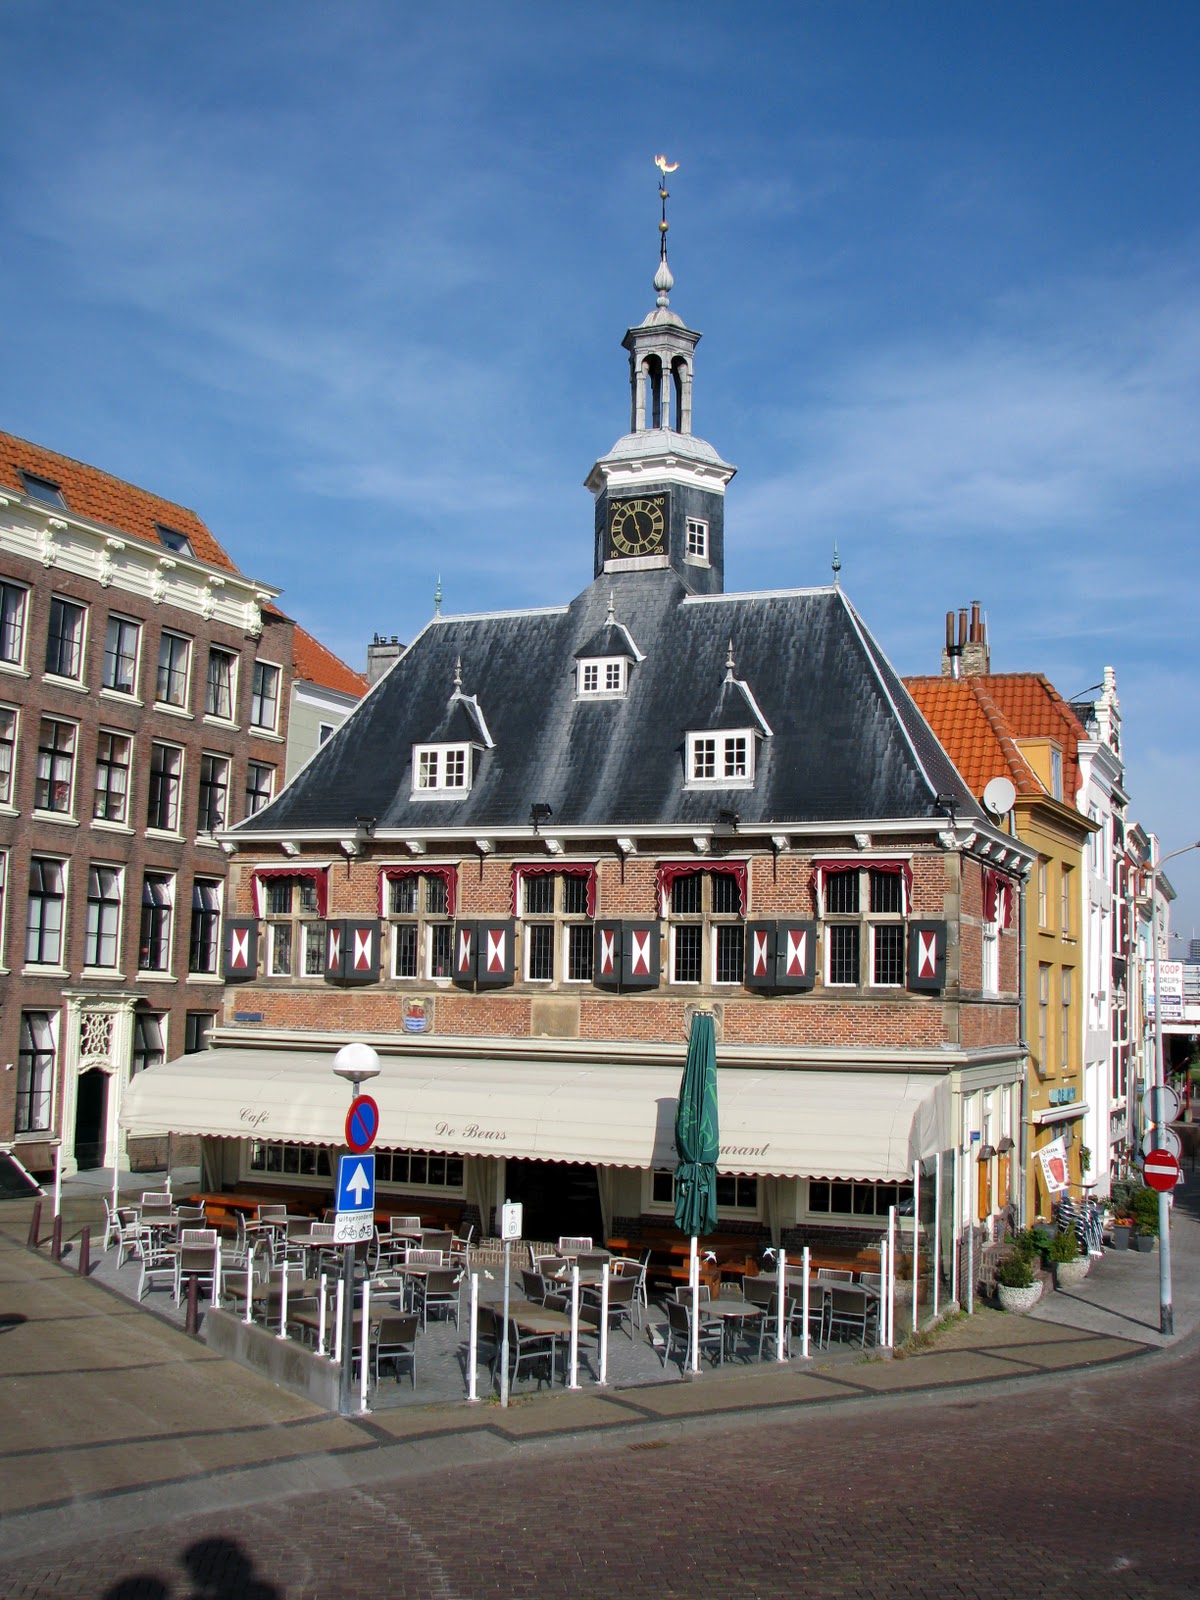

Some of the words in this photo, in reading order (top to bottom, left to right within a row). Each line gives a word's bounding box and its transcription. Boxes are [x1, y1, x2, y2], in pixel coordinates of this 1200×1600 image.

[653, 498, 665, 506] NO
[1160, 965, 1180, 975] KOOP
[240, 1107, 270, 1128] Café
[435, 1121, 456, 1137] De
[462, 1123, 507, 1140] Beurs
